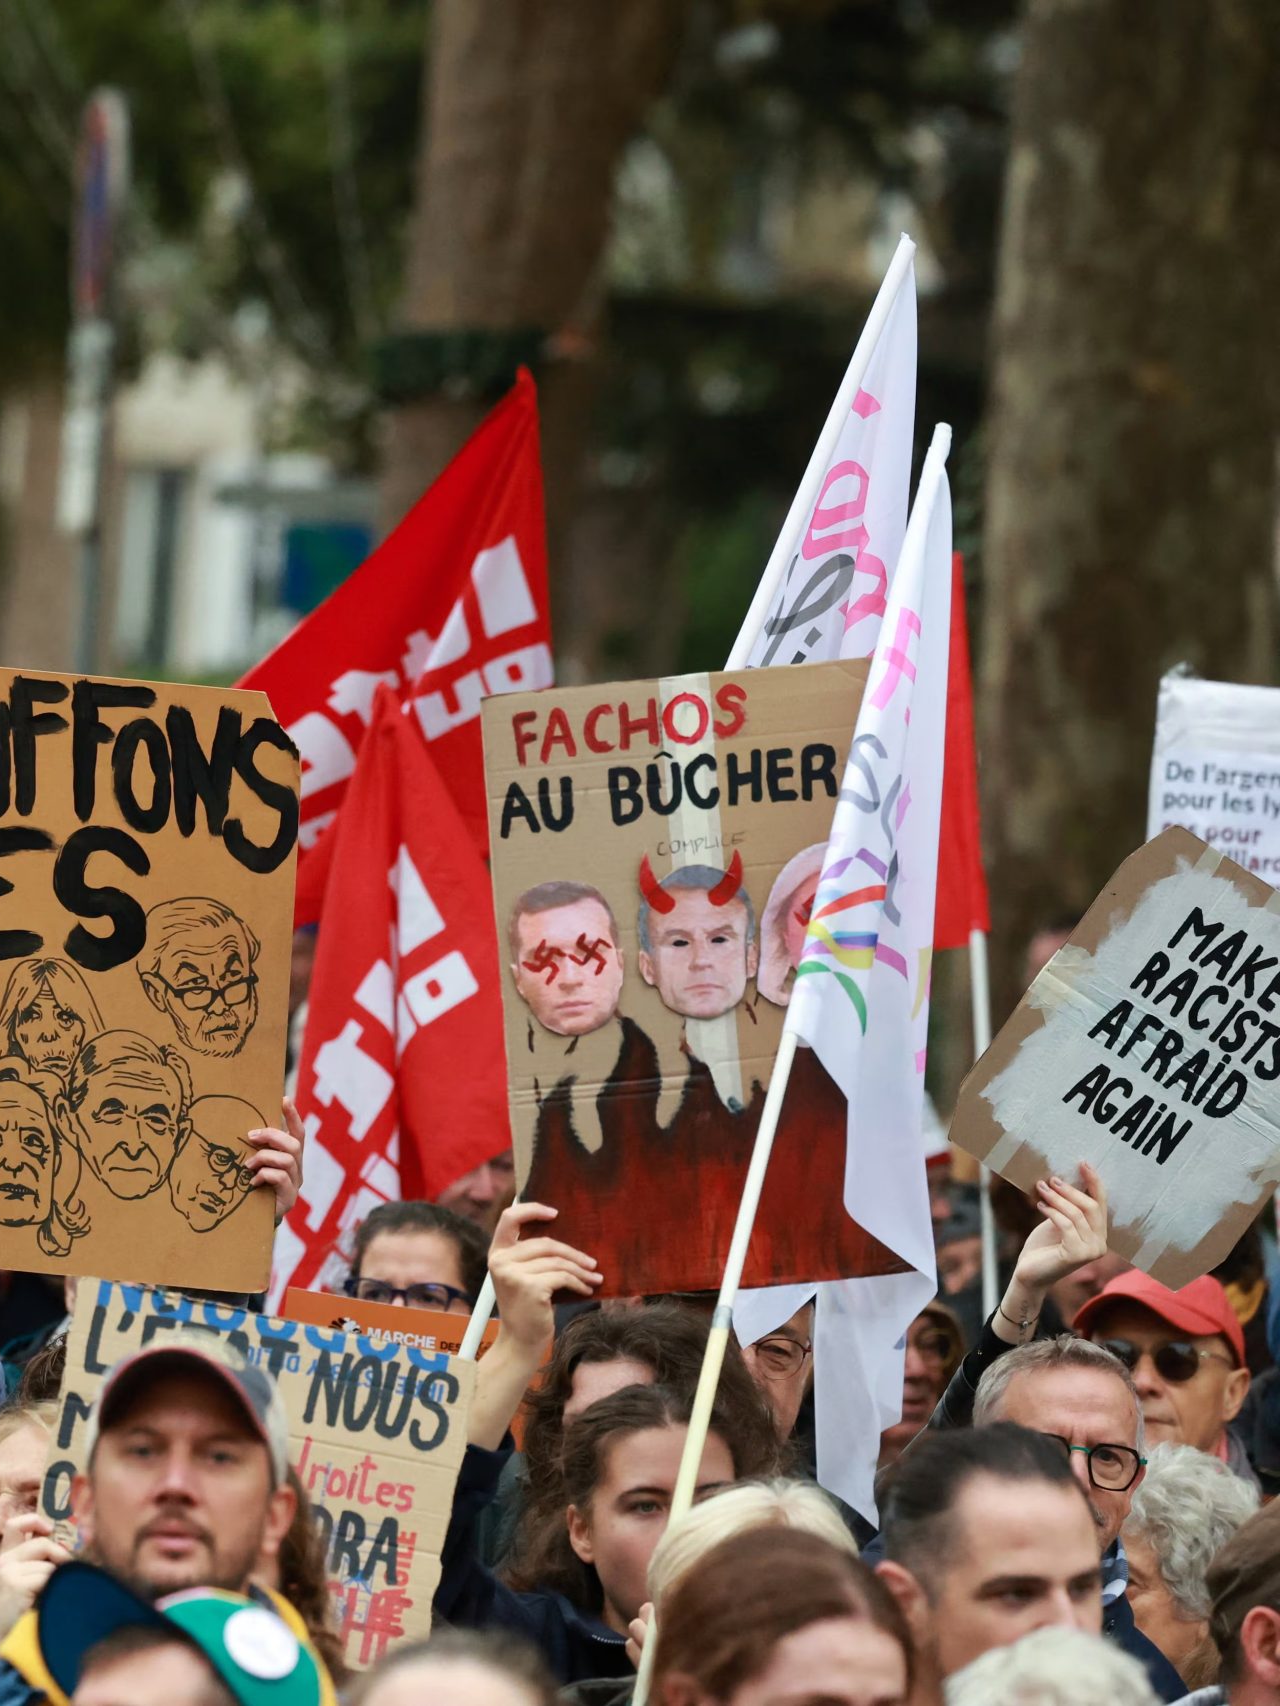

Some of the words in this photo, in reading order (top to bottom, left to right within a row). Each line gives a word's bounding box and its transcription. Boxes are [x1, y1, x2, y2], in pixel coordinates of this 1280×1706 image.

[512, 683, 748, 768] FACHOS
[500, 776, 574, 839] AU
[608, 743, 839, 827] BÛCHER
[1163, 793, 1216, 812] pour
[1222, 791, 1254, 814] les
[1165, 761, 1195, 782] De
[1129, 950, 1280, 1080] RACISTS
[366, 1326, 436, 1350] MARCHE
[303, 1349, 460, 1451] NOUS
